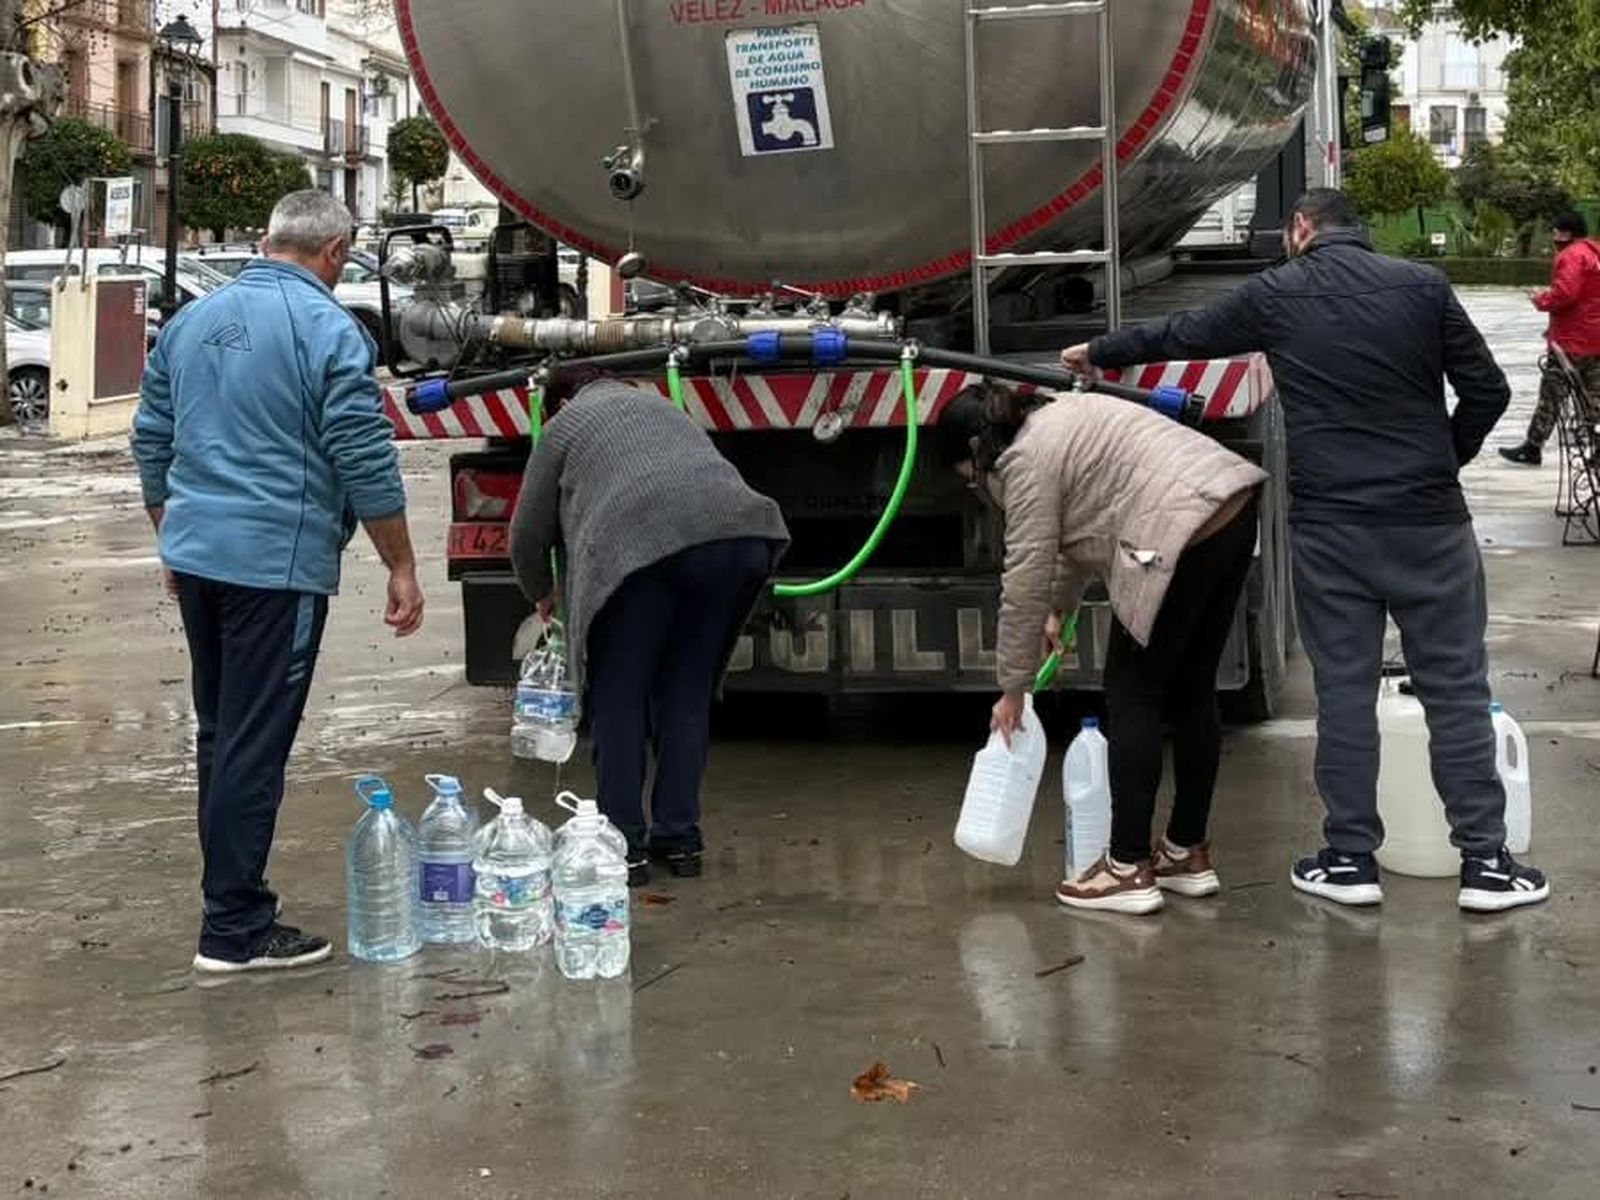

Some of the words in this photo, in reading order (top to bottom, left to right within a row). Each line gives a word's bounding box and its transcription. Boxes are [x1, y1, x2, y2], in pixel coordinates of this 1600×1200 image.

[736, 37, 815, 53] TRANSPORTE
[748, 55, 764, 65] DE
[767, 51, 804, 62] AGUA
[735, 68, 750, 78] DE
[754, 61, 820, 76] CONSUMO
[750, 75, 809, 89] HUMANO
